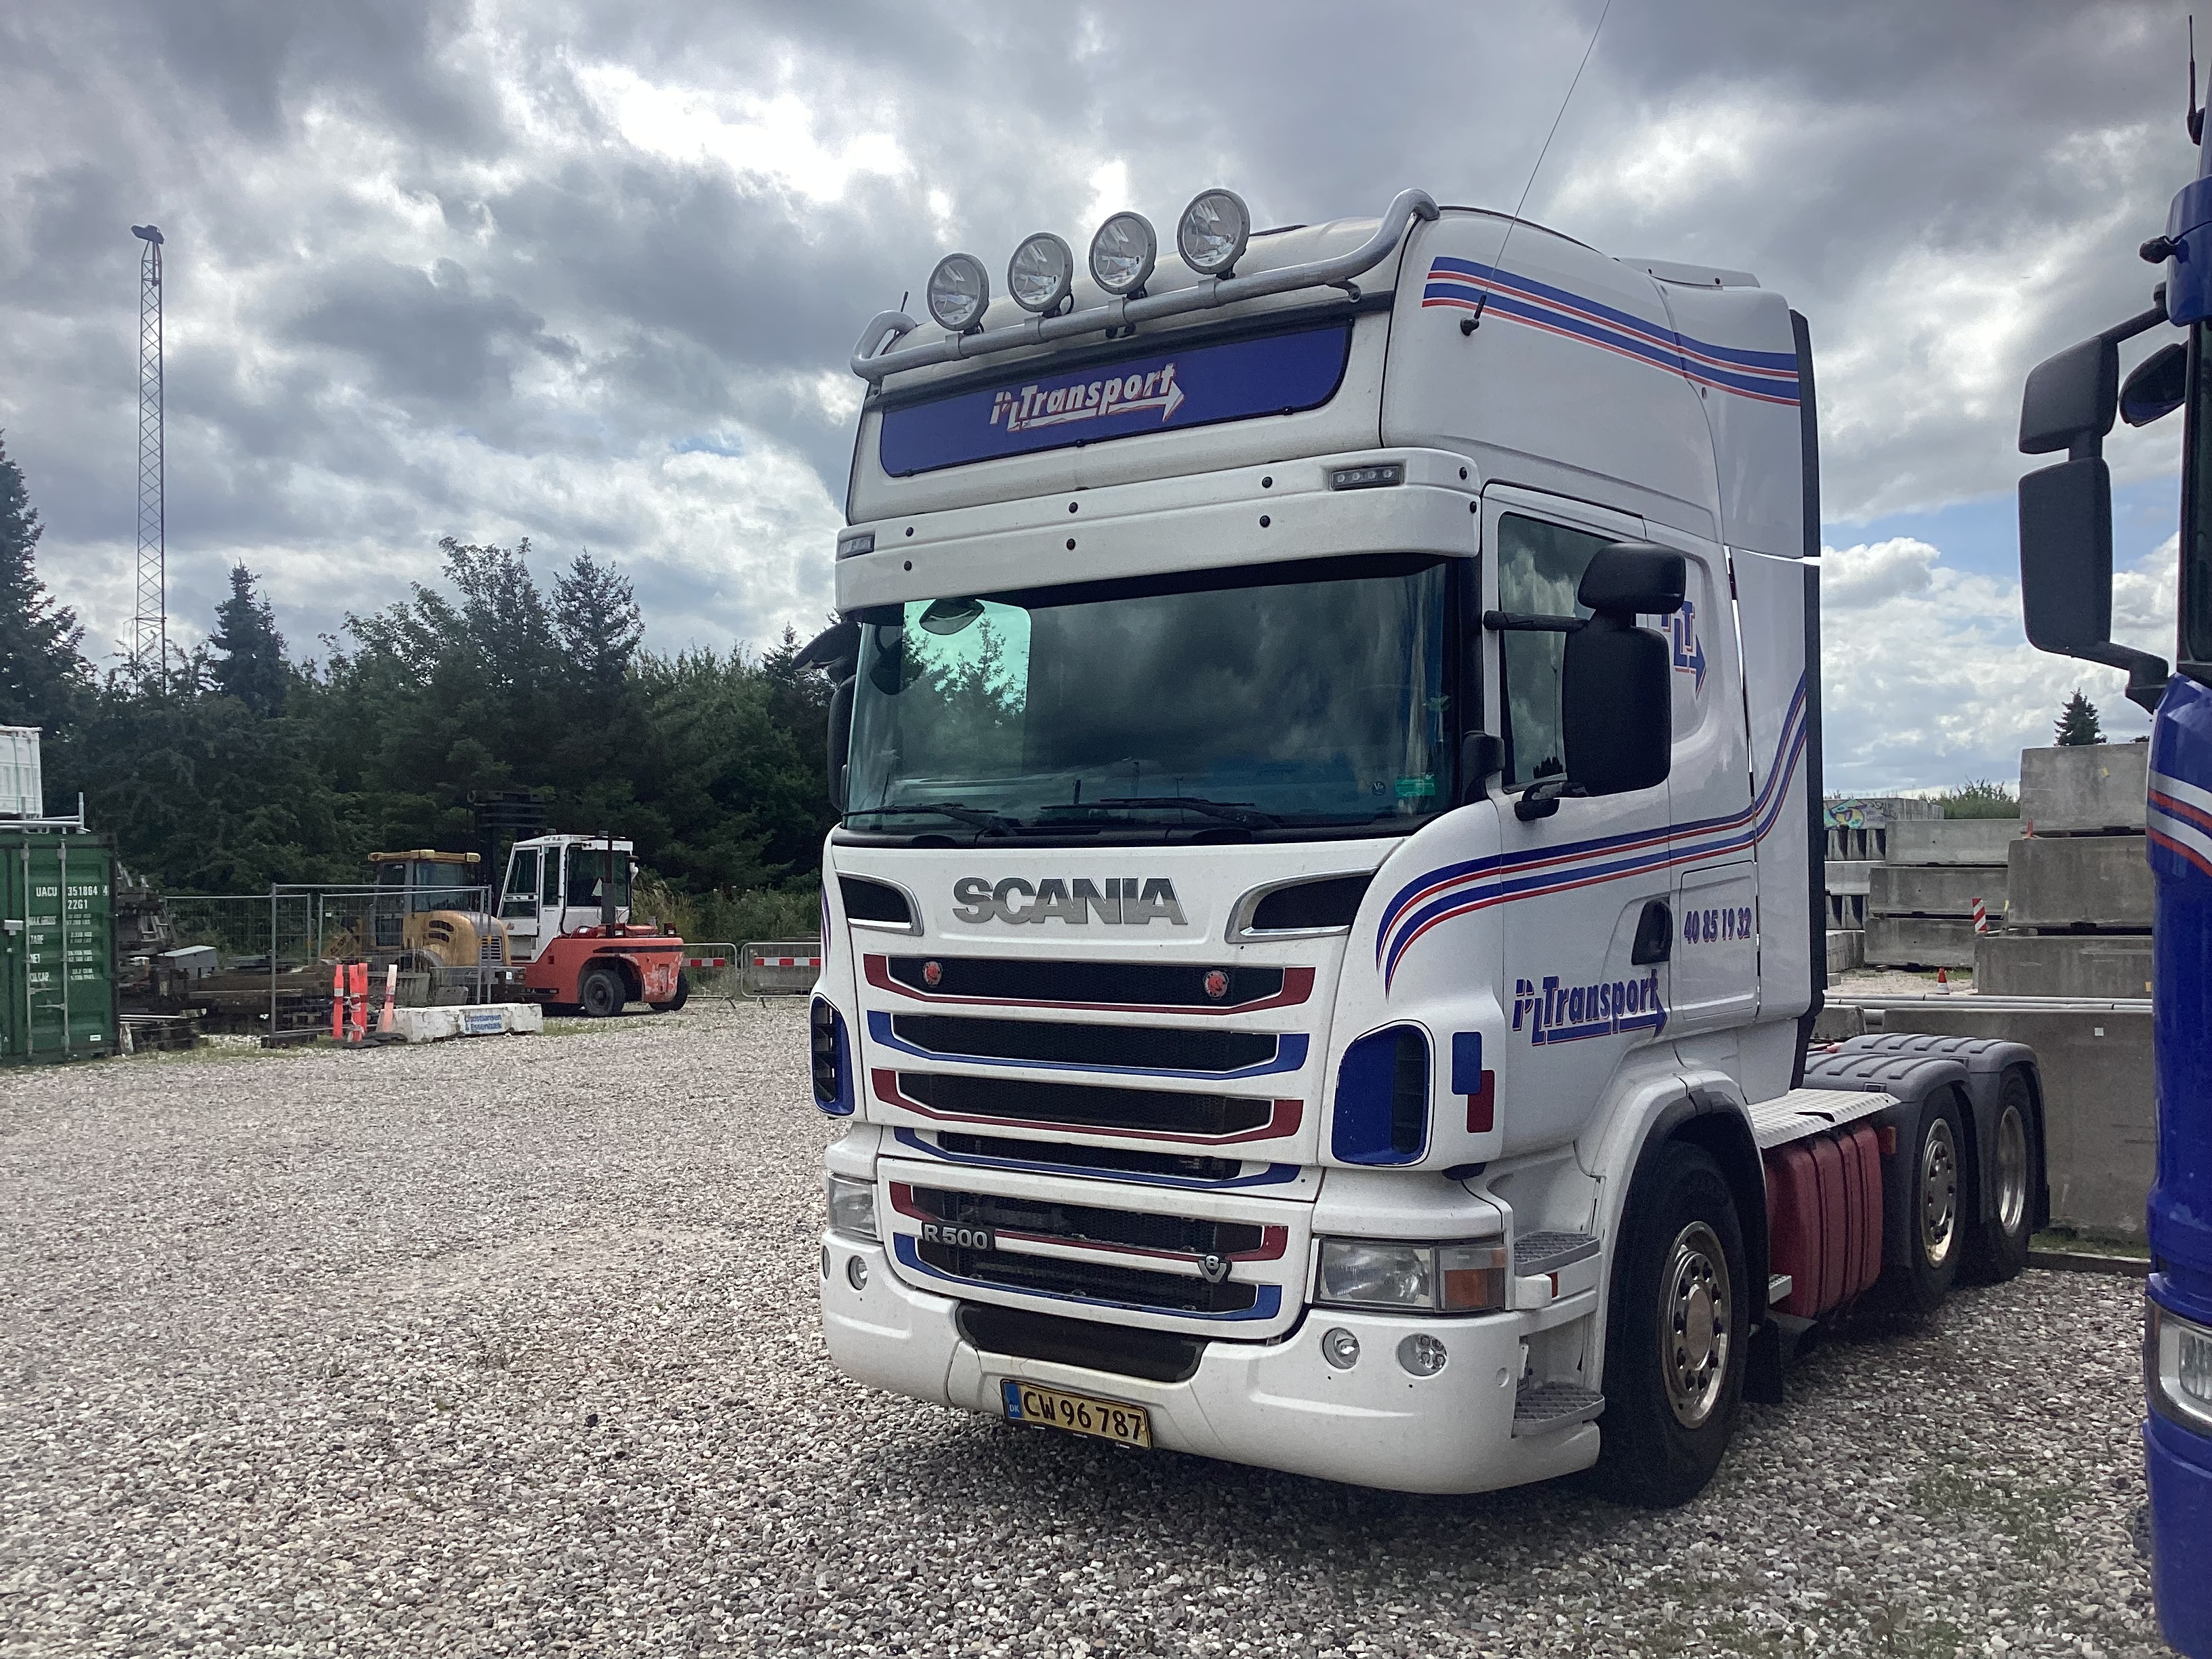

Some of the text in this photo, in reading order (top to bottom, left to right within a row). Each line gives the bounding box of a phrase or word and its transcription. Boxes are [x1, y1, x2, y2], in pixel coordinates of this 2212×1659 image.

[1019, 363, 1176, 416] Transport
[36, 886, 58, 897] UACU
[67, 899, 88, 909] 22G1
[952, 877, 1188, 924] SCANIA
[1683, 907, 1752, 945] 40 85 19 32
[1543, 969, 1658, 1035] Transport
[1009, 1404, 1020, 1412] DK
[1023, 1391, 1142, 1440] CW 96 787
